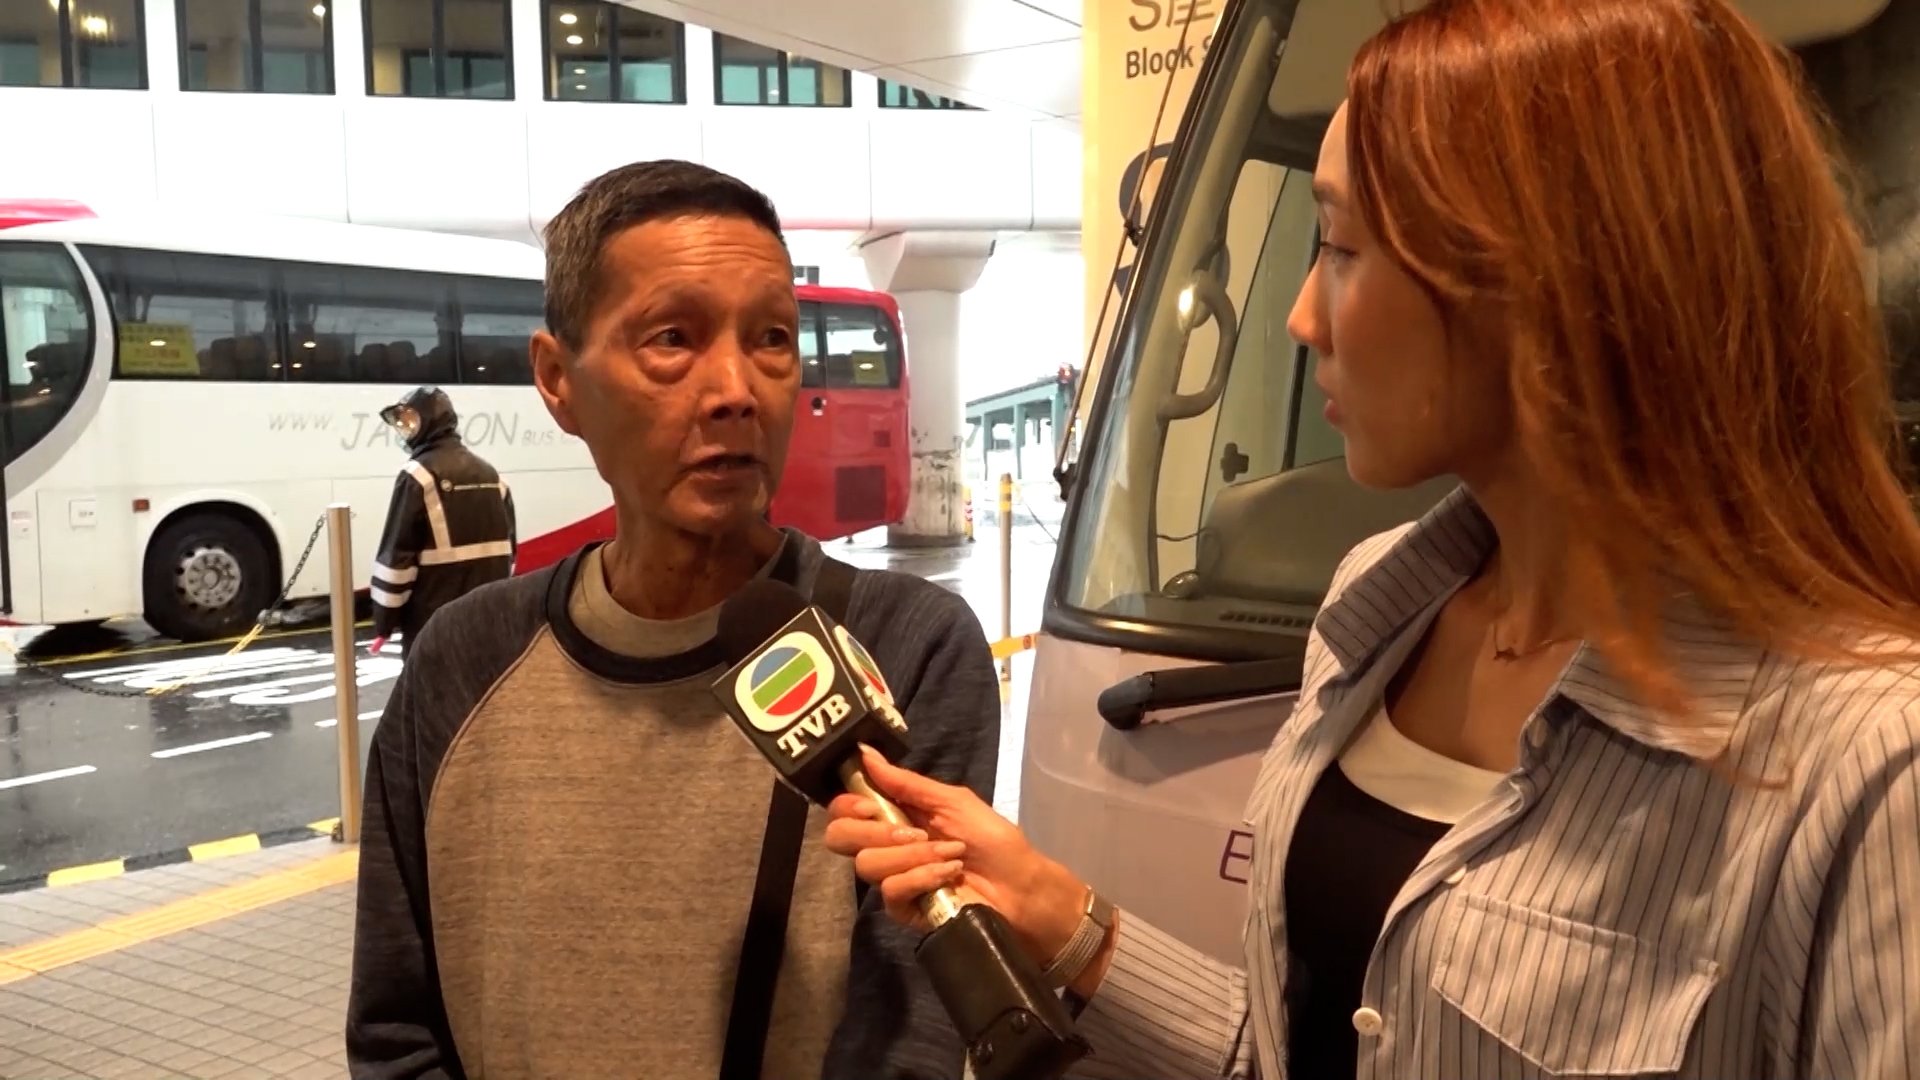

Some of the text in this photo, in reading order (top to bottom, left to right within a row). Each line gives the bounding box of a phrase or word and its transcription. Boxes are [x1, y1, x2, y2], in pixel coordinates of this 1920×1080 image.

[1126, 45, 1194, 79] Block
[341, 411, 518, 451] JAON
[776, 693, 852, 758] TVB
